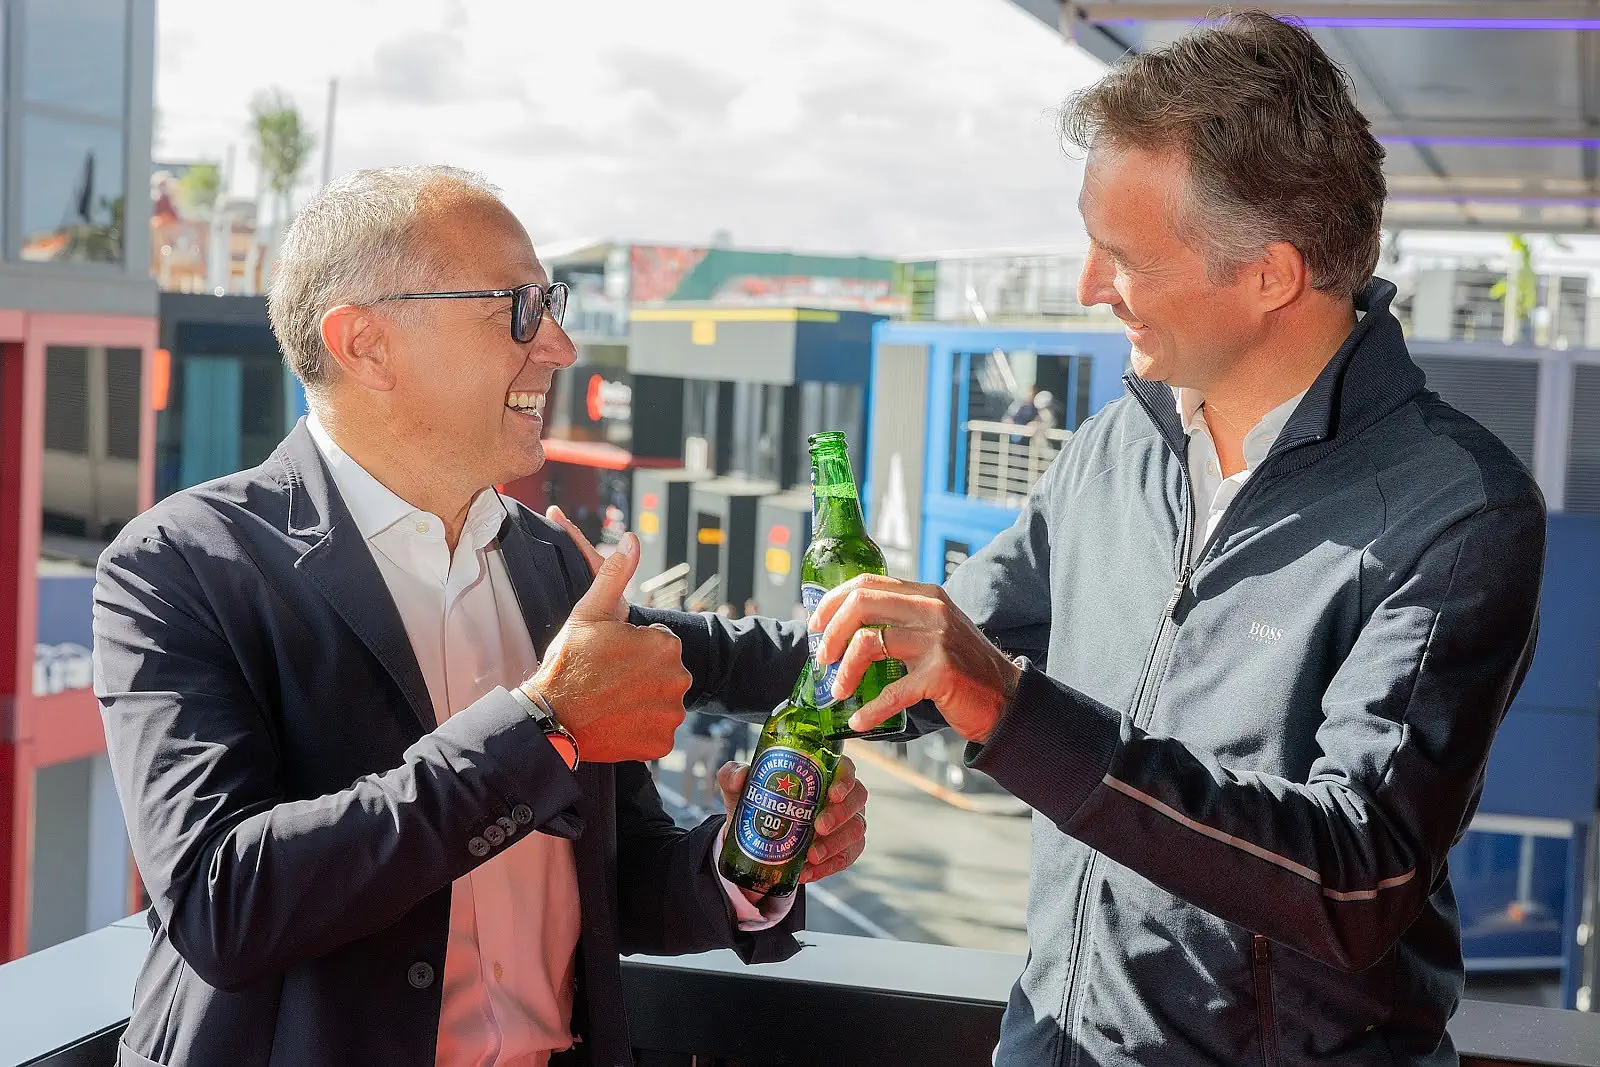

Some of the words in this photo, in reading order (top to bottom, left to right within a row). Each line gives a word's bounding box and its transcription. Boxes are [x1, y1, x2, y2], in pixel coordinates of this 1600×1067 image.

[1249, 621, 1284, 641] BOSS
[757, 758, 796, 780] HEINEKEN
[796, 765, 808, 777] 0.0
[805, 775, 816, 797] BEER
[746, 785, 814, 821] Heineken
[743, 819, 753, 841] PURE
[752, 837, 774, 853] MALT
[776, 835, 798, 853] LAGER
